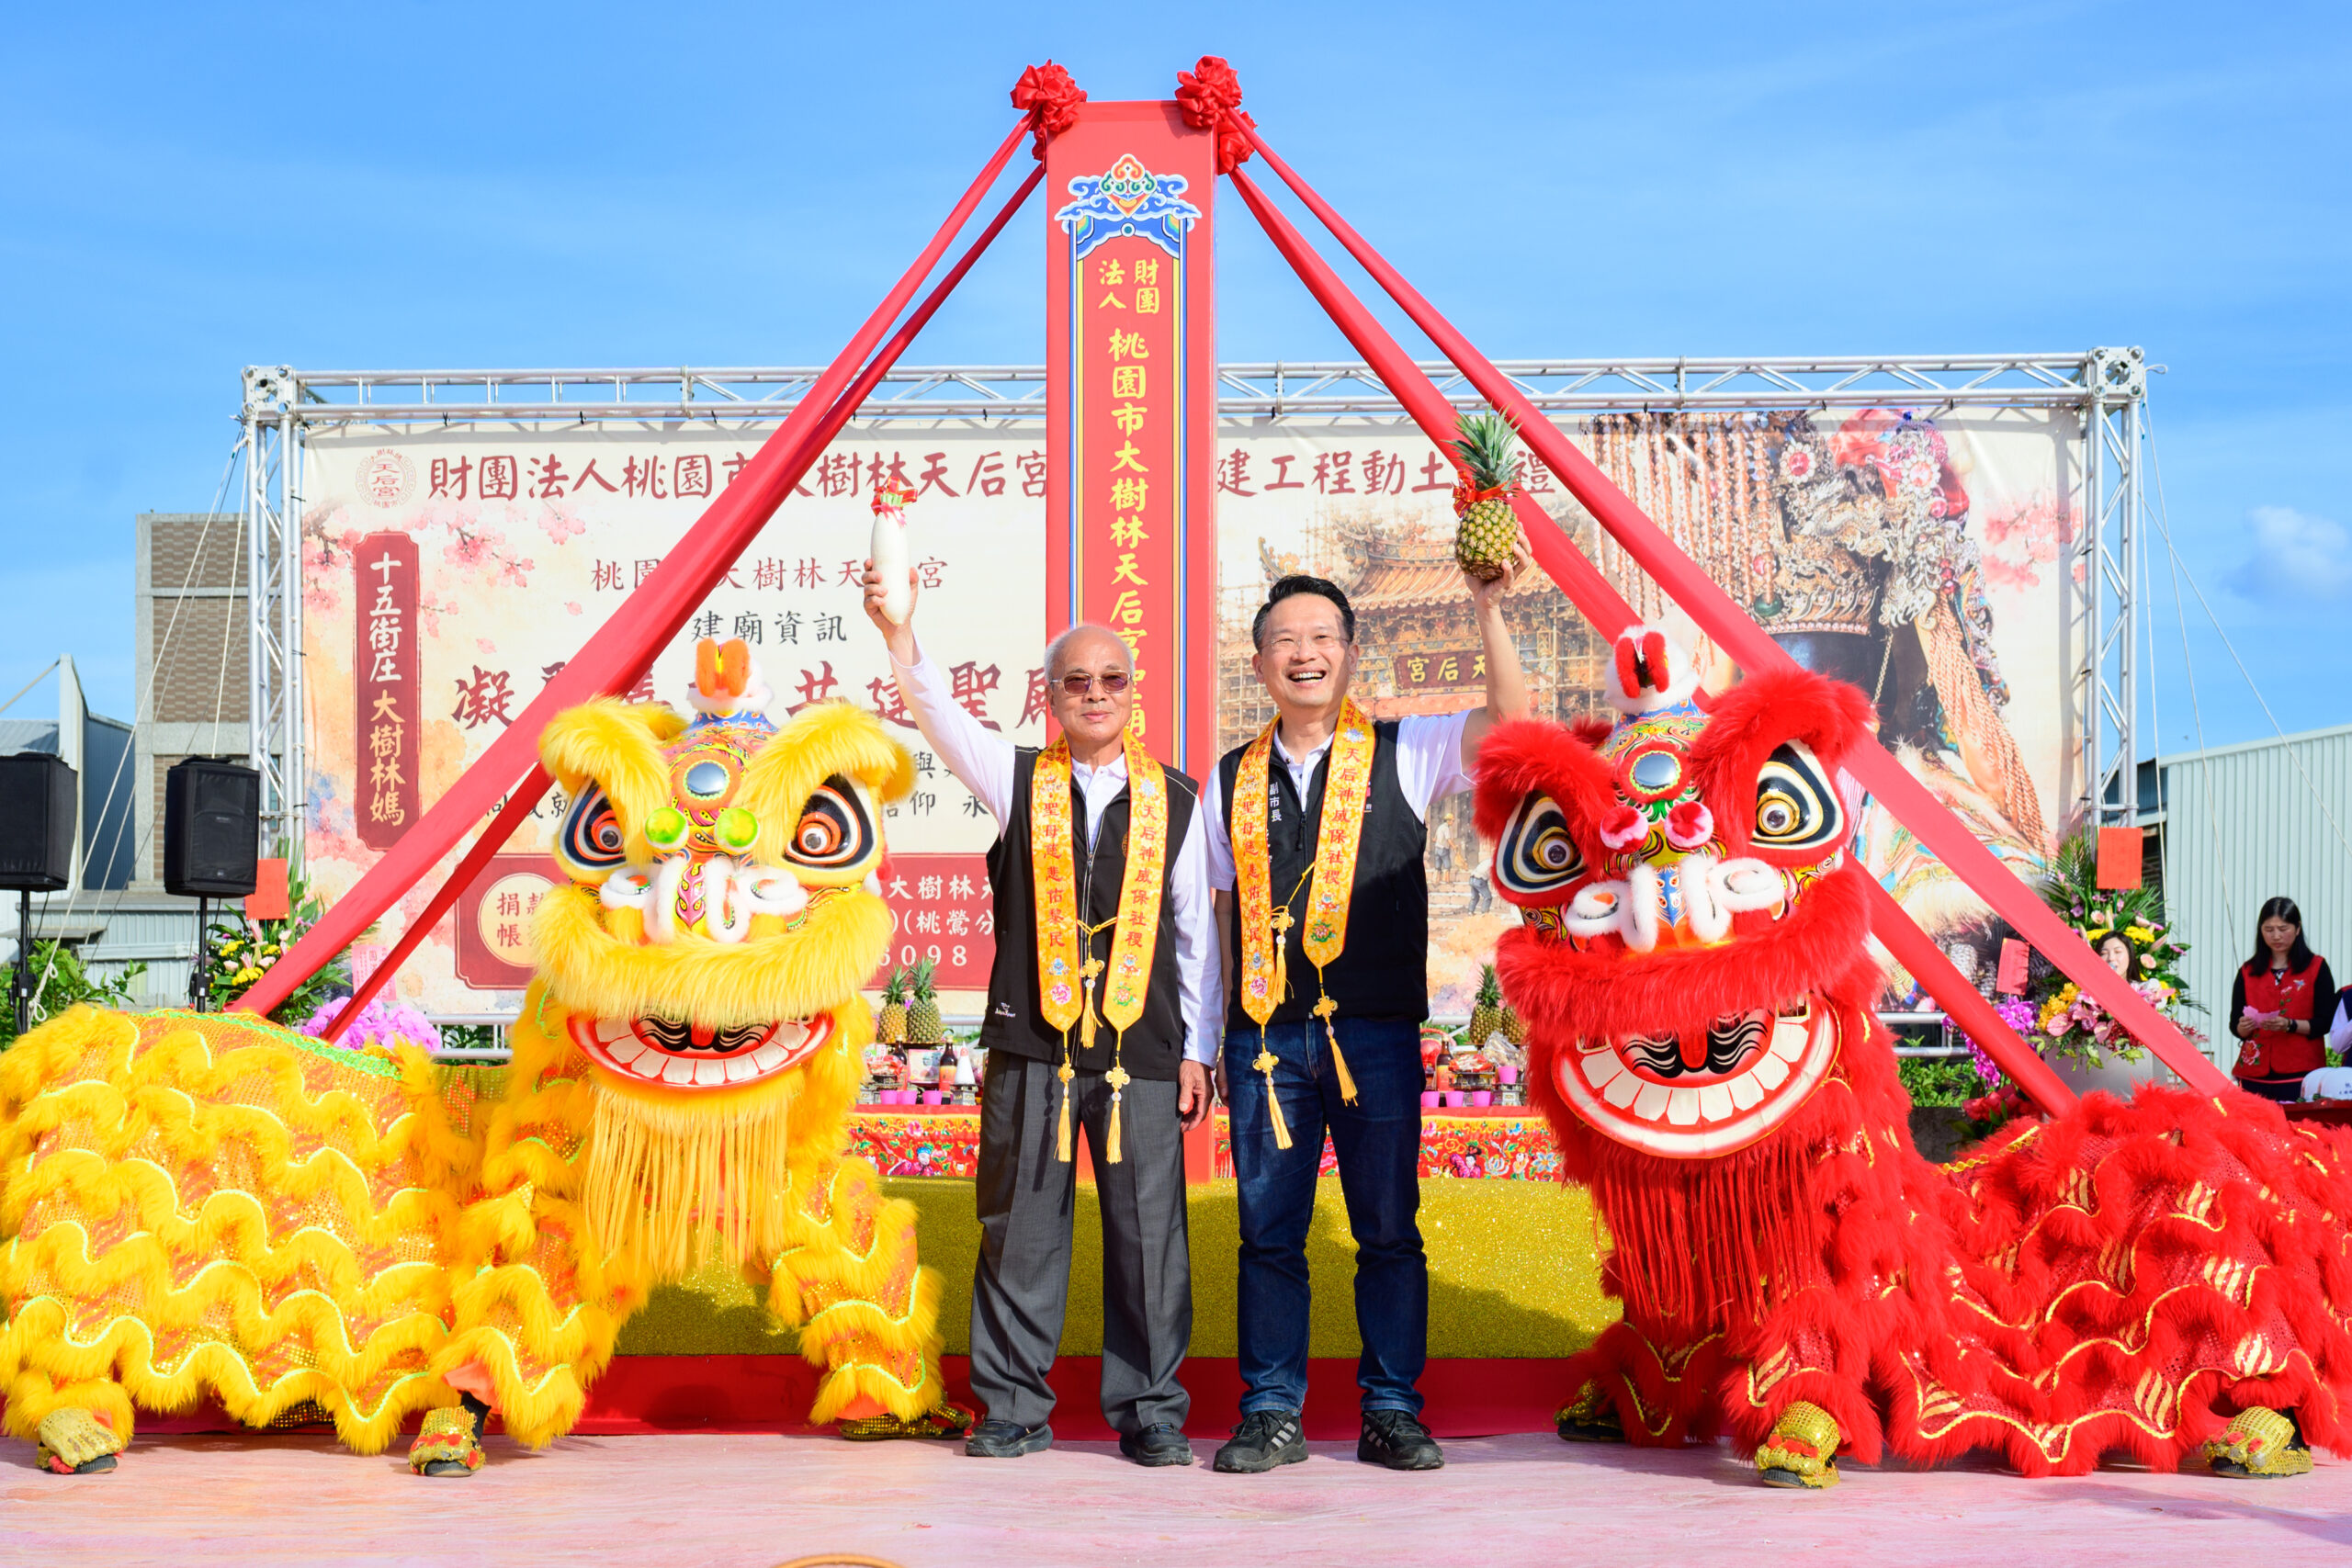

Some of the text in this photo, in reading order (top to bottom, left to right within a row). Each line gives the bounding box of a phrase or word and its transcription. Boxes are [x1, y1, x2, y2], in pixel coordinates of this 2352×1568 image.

[1098, 258, 1126, 310] 法人
[1134, 258, 1159, 314] 財團
[371, 463, 400, 497] 天后宮
[1217, 448, 1555, 497] 建工程動土禮
[691, 610, 847, 645] 建廟資訊
[369, 690, 406, 827] 大樹林媽
[1269, 782, 1283, 823] 副市長
[1324, 747, 1362, 886] 天后神威保社稷
[1125, 805, 1159, 949] 天后神威保社稷
